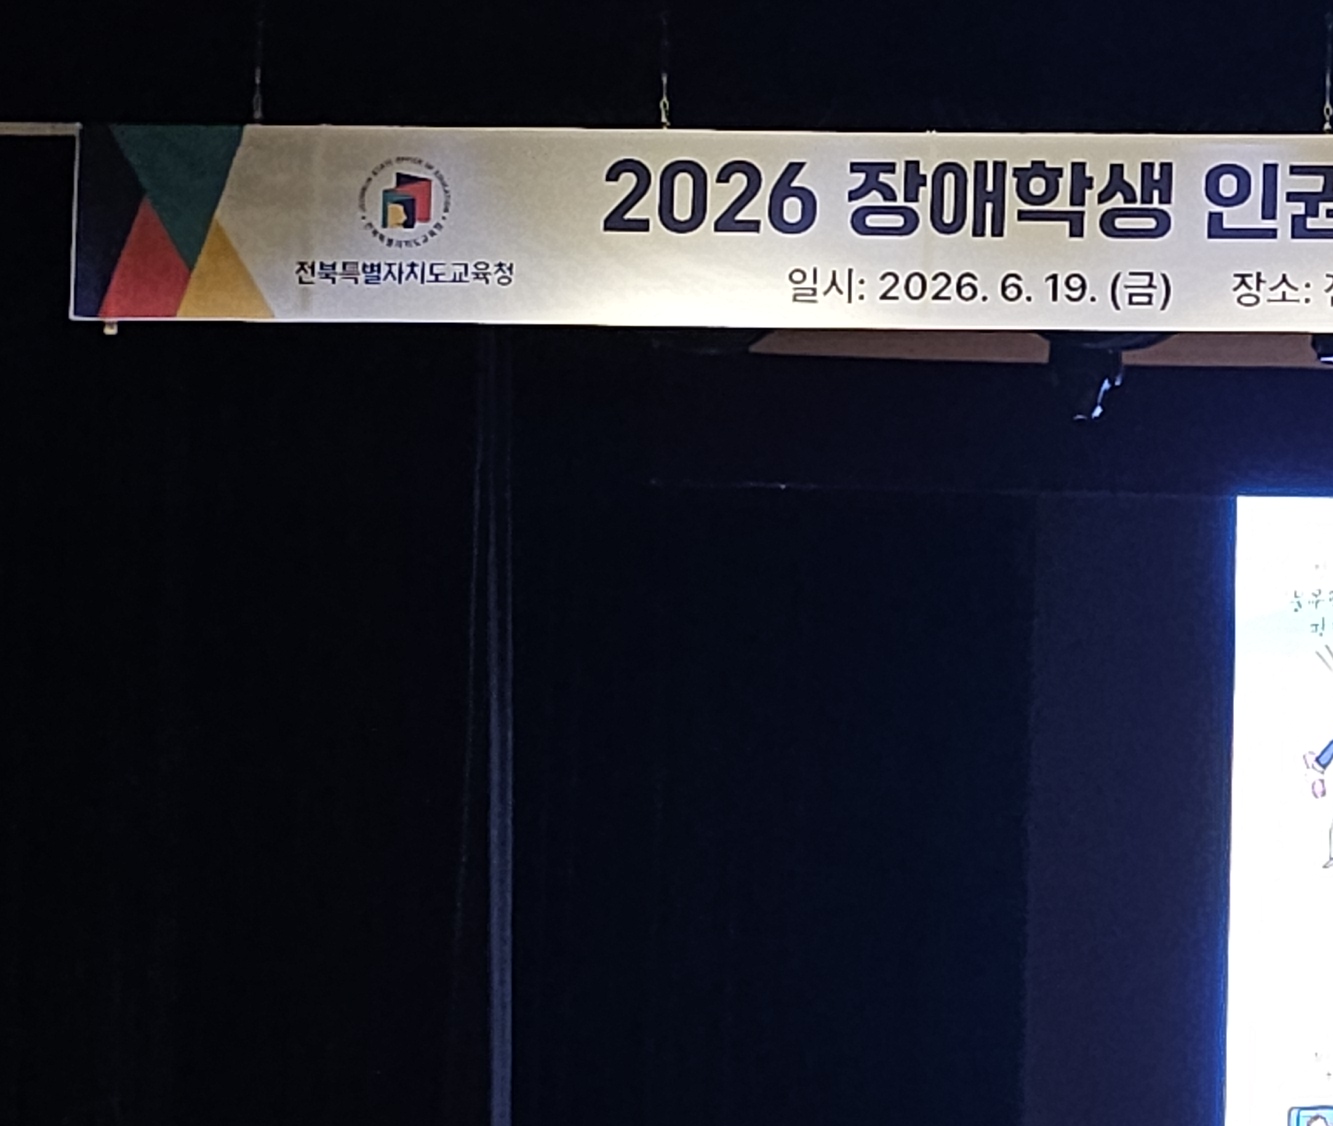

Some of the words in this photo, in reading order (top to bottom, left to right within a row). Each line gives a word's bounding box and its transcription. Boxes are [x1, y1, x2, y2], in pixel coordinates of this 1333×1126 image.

[604, 159, 816, 234] 2026
[848, 160, 1172, 238] 장애학생
[296, 261, 513, 285] 전북특별자치도교육청
[789, 268, 864, 303] 일시:
[880, 272, 987, 301] 2026.
[1001, 274, 1031, 301] 6.
[1046, 274, 1095, 301] 19.
[1111, 272, 1170, 310] (금)
[1233, 272, 1310, 306] 장소:
